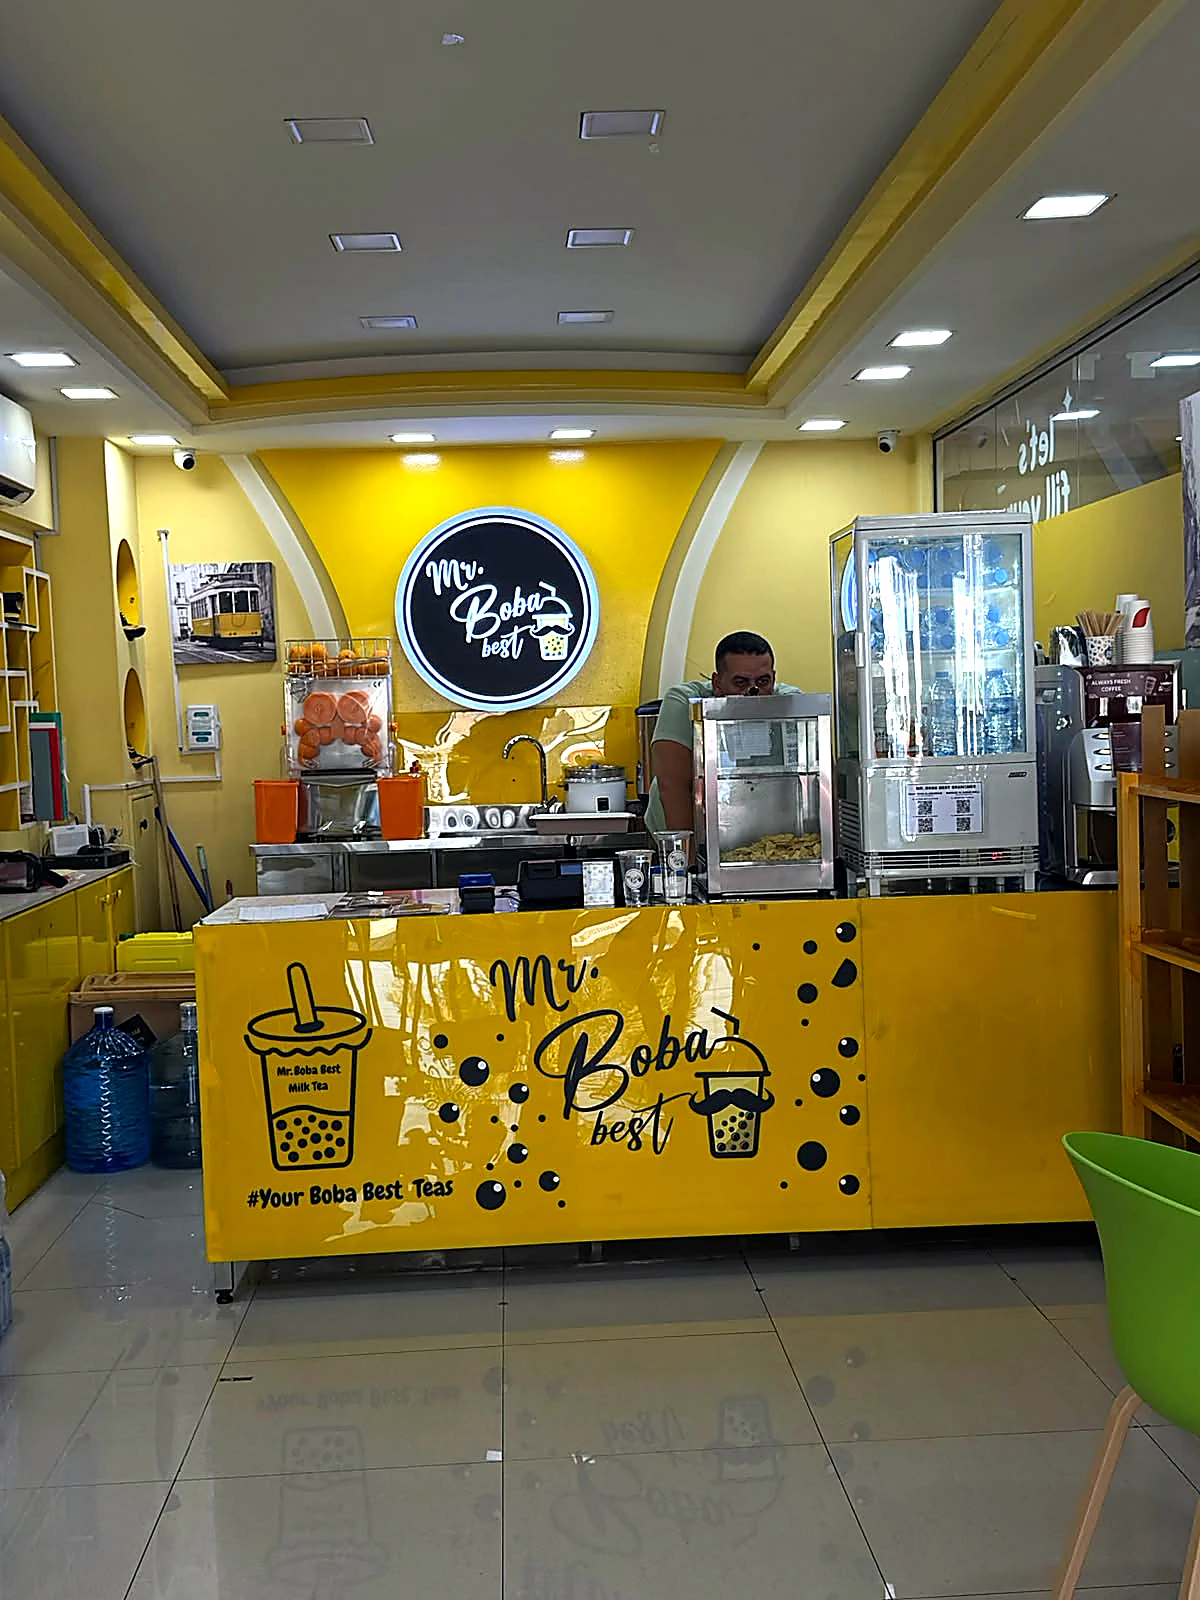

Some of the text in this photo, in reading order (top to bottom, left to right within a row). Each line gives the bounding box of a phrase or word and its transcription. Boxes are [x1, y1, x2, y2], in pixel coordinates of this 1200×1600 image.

[425, 559, 484, 596] Mr.
[450, 584, 545, 644] Boba
[481, 625, 532, 660] best
[489, 954, 599, 1022] Mr.
[294, 1065, 318, 1075] Boba
[320, 1063, 341, 1074] Best
[533, 1008, 712, 1120] Boba
[288, 1080, 328, 1093] Milk Tea
[590, 1092, 690, 1156] best
[247, 1178, 454, 1209] #Your Boba Best Teas
